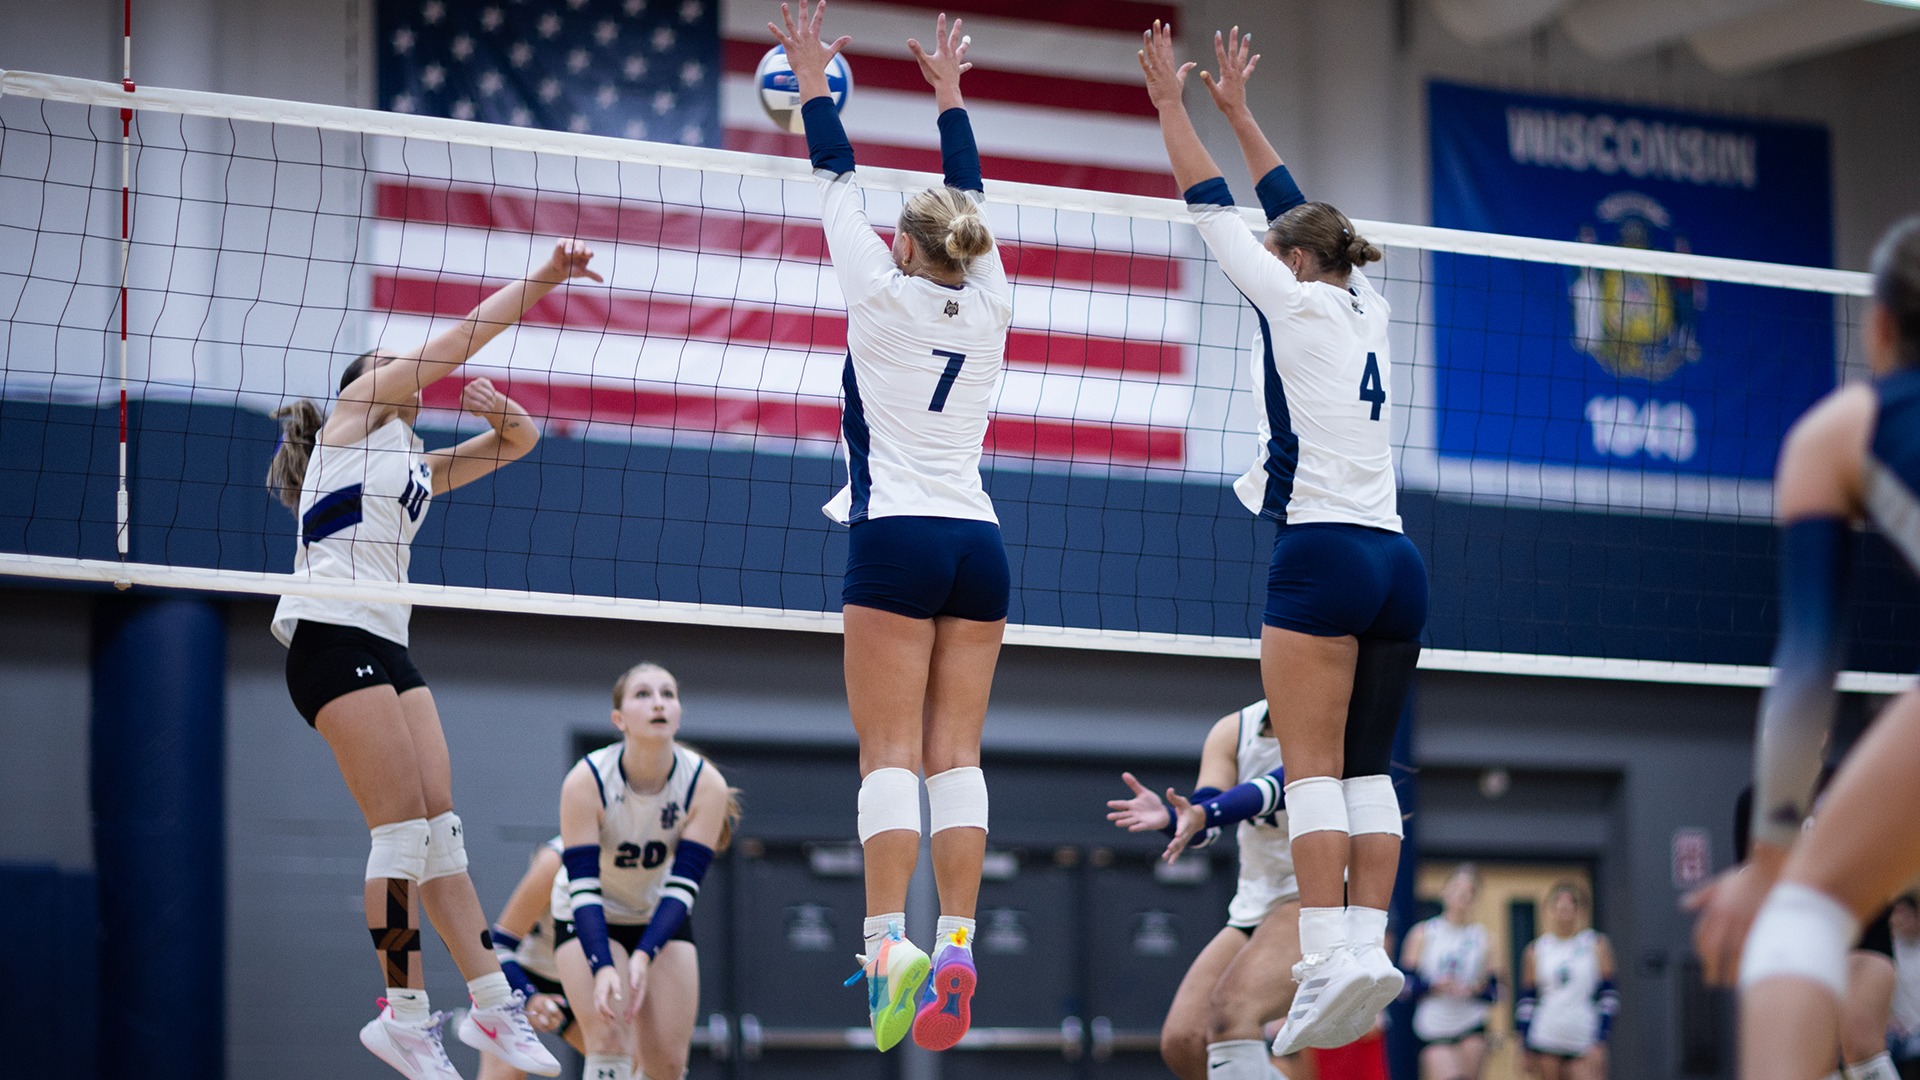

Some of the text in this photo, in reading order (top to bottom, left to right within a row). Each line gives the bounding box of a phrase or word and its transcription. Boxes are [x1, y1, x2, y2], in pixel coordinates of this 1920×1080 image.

[1507, 106, 1757, 188] WISCONSIN
[928, 349, 967, 413] 7
[1359, 352, 1386, 421] 4
[1586, 397, 1697, 462] 1848
[614, 840, 668, 869] 20
